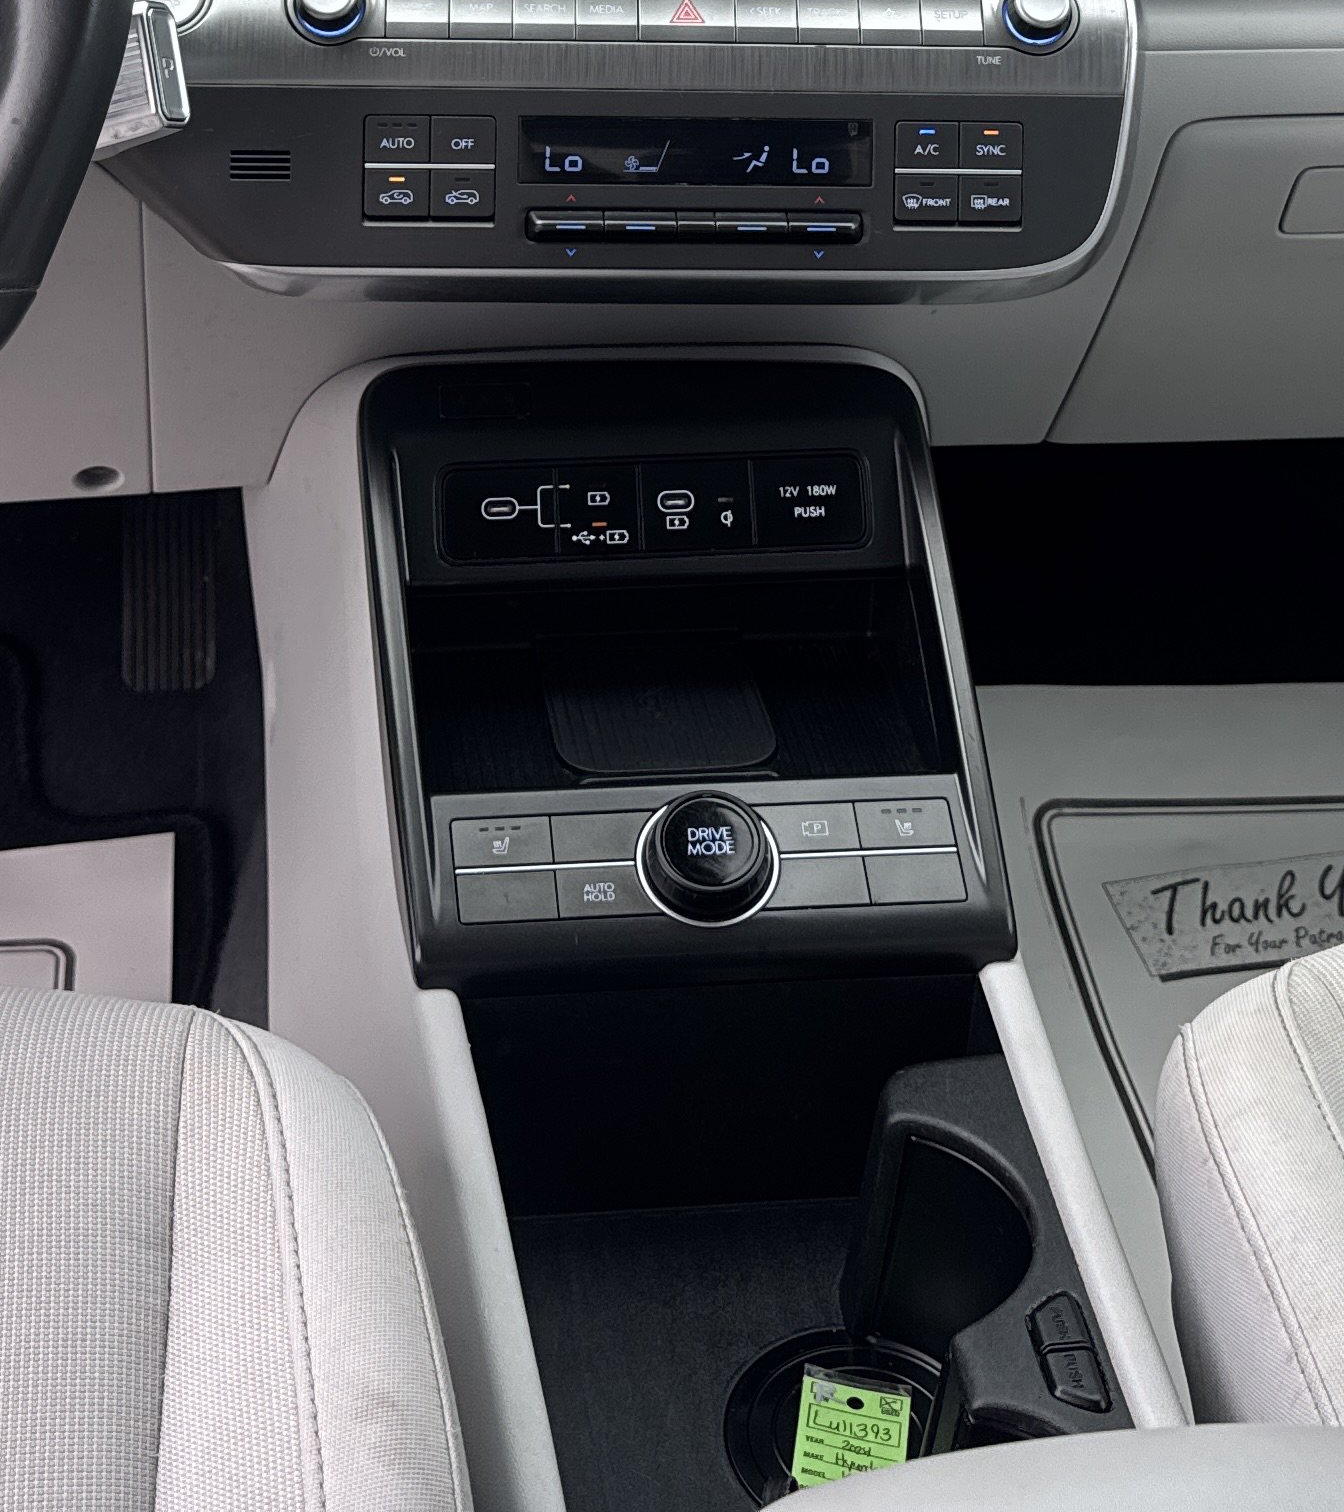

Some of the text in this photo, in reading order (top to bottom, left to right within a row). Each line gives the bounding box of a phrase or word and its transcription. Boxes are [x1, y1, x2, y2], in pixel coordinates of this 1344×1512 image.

[469, 3, 495, 13] MAP
[523, 3, 567, 14] SEARCH
[589, 3, 624, 15] MEDIA
[934, 9, 969, 20] SETUP
[976, 55, 1002, 66] TUNE
[379, 137, 415, 150] AUTO
[450, 138, 475, 150] OFF
[913, 144, 940, 156] A/C
[975, 144, 1007, 156] SYNC
[544, 146, 583, 172] Lo
[791, 147, 830, 174] Lo
[922, 198, 952, 207] FRONT
[987, 197, 1010, 206] REAR
[779, 484, 837, 497] 12V 180W
[793, 506, 825, 518] PUSH
[687, 826, 732, 842] DRIVE
[687, 840, 736, 856] MODE
[583, 882, 615, 892] AUTO
[583, 891, 616, 902] HOLD
[1150, 869, 1306, 935] Thank
[1210, 934, 1242, 957] For
[1248, 932, 1287, 954] Your
[1062, 1353, 1085, 1390] PUSH
[805, 1434, 824, 1445] YEAR
[802, 1450, 824, 1462] MAKE
